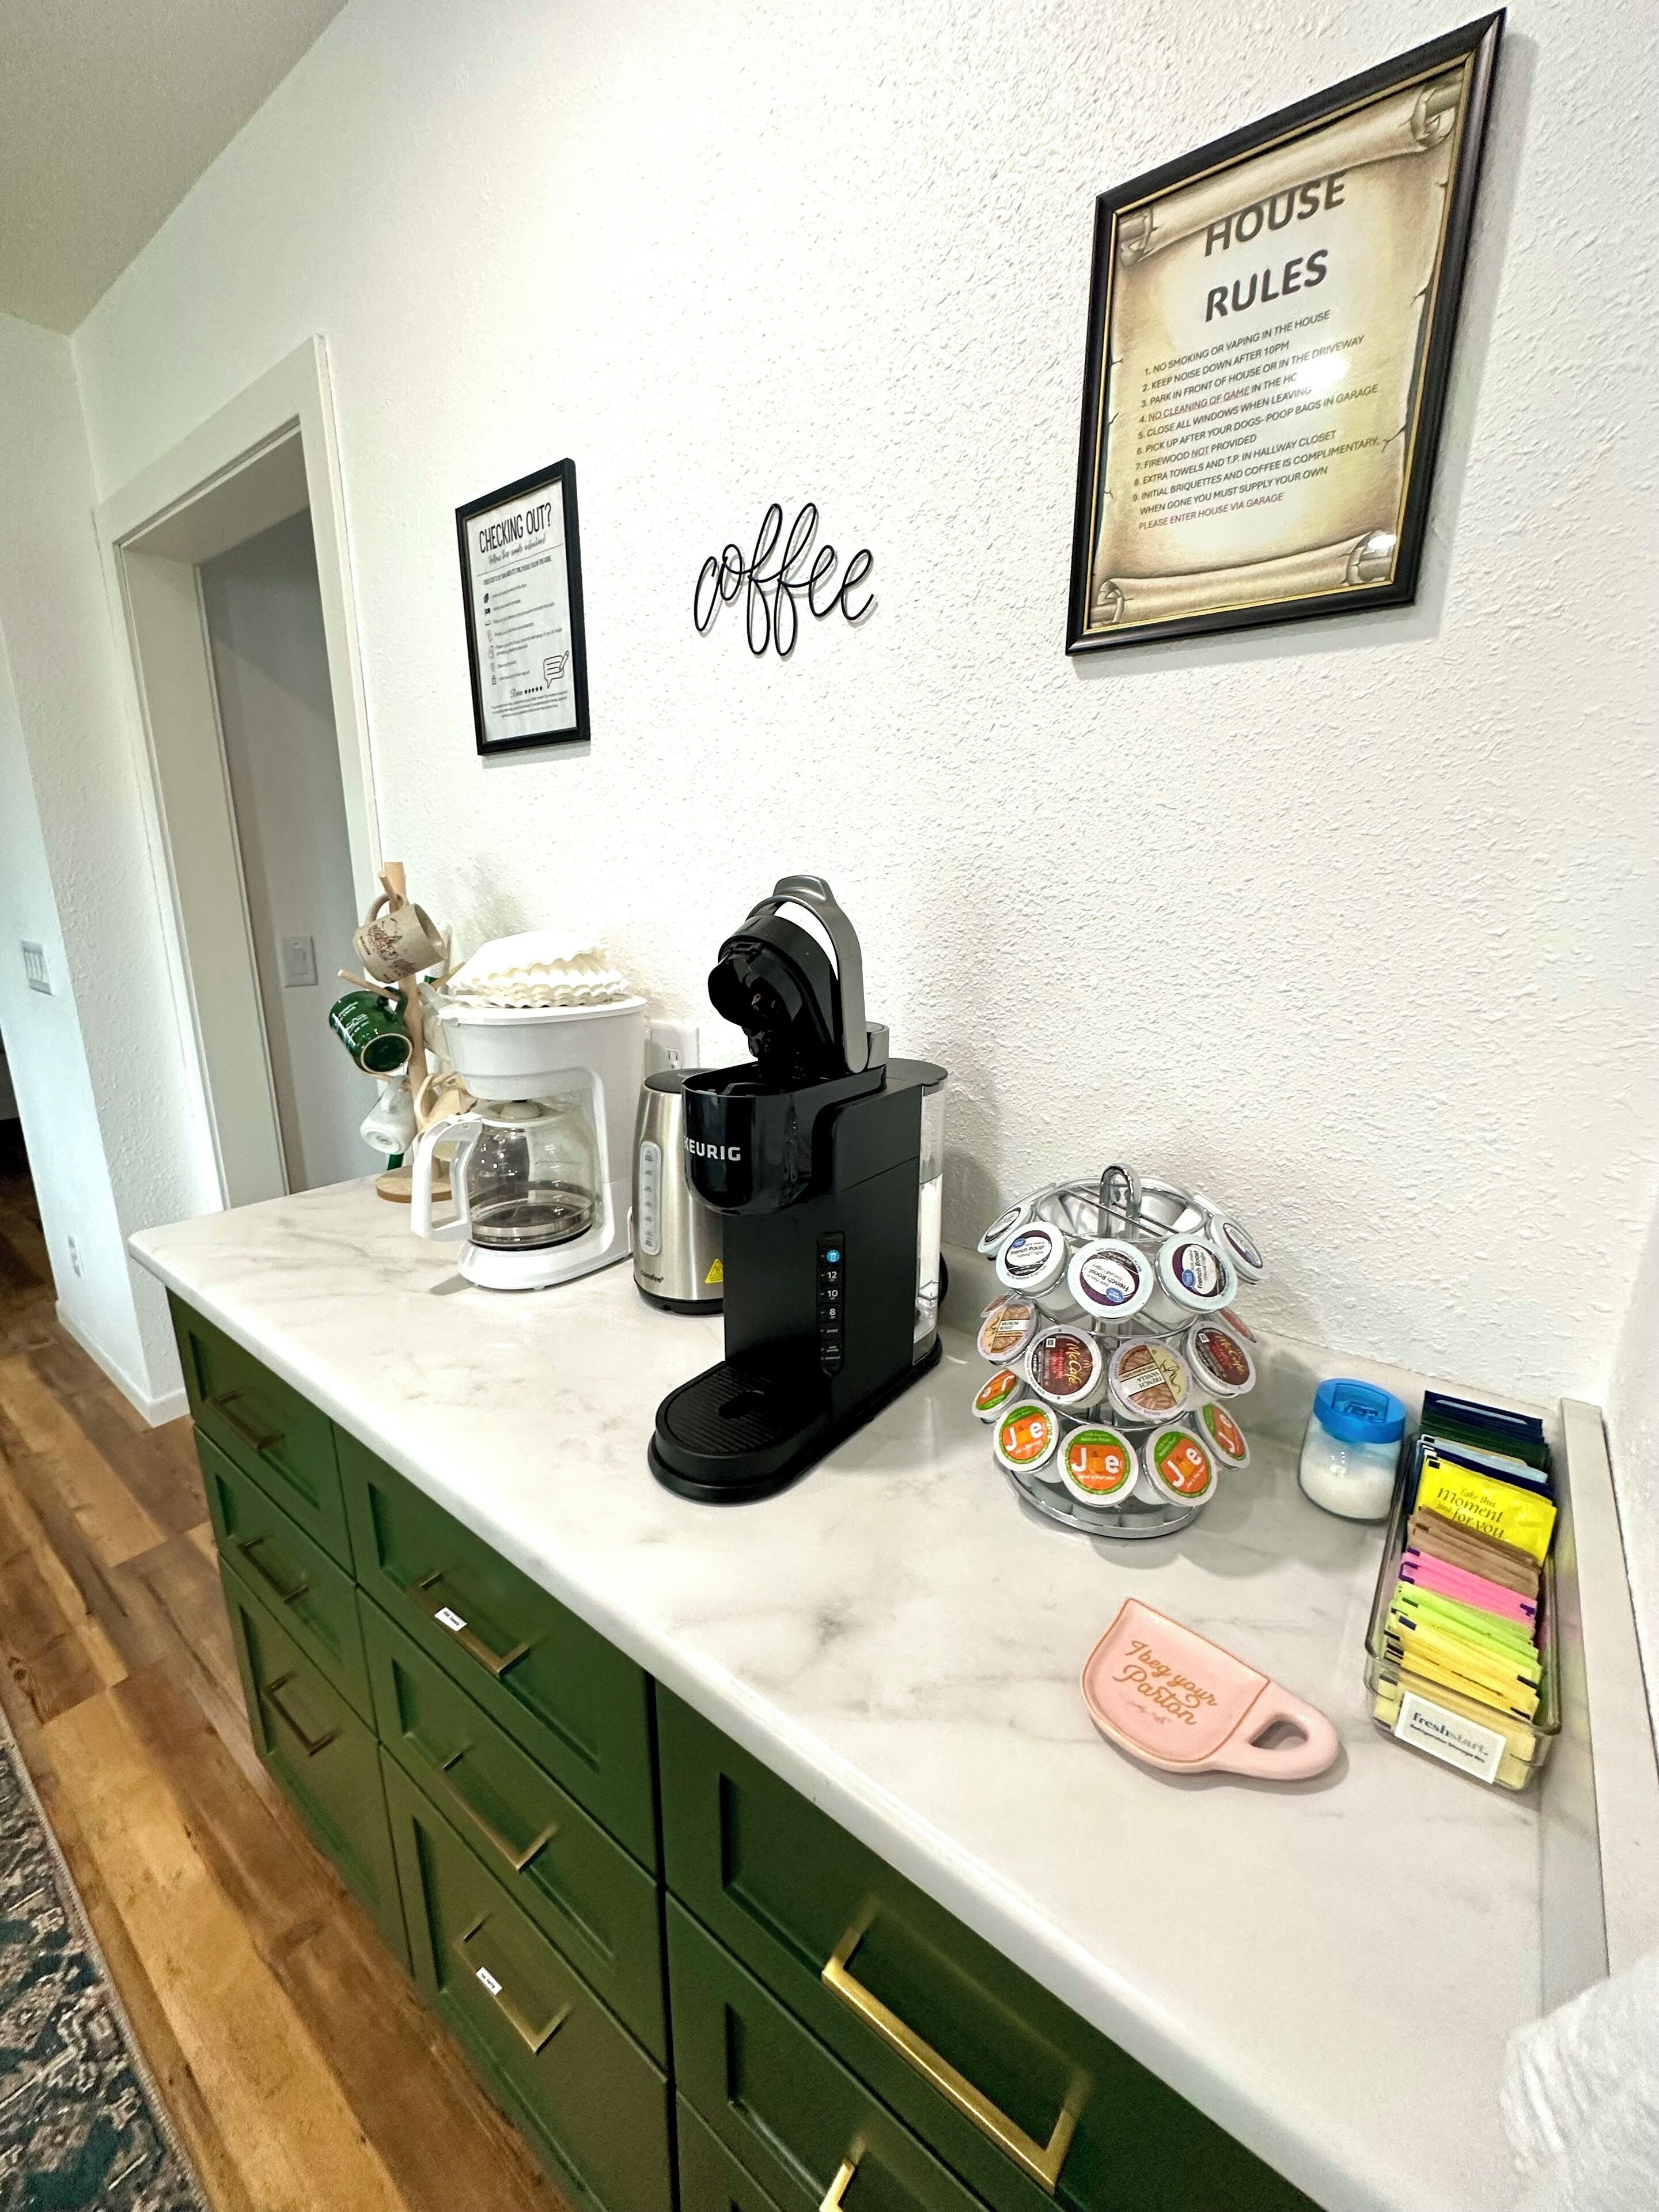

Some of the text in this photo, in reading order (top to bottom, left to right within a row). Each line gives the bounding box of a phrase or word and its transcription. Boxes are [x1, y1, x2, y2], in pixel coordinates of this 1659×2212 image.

[1204, 170, 1348, 257] HOUSE
[1205, 248, 1329, 323] RULES
[1153, 362, 1166, 373] NO
[1168, 349, 1210, 369] SMOKING
[1211, 344, 1224, 355] OR
[1226, 332, 1260, 351] VAPING
[1262, 329, 1272, 339] IN
[1275, 322, 1293, 335] THE
[1294, 309, 1331, 329] HOUSE
[1141, 335, 1365, 408] 3. PARK IN FRONT OF HOUSE OR IN THE DRIVEWAY
[1142, 340, 1290, 392] 2. KEEP NOISE DOWN AFTER 10PM
[1137, 447, 1144, 455] 6.
[1145, 441, 1165, 453] PICK
[1166, 438, 1179, 448] UP
[1179, 431, 1206, 445] AFTER
[1207, 424, 1233, 438] YOUR
[1266, 407, 1294, 423] POOP
[1295, 399, 1322, 415] BAGS
[1323, 396, 1335, 407] IN
[1335, 382, 1380, 403] GARAGE
[1138, 415, 1147, 423] 4.
[1148, 411, 1162, 423] NO
[1163, 399, 1208, 418] CLEANING
[1209, 394, 1223, 406] OF
[1223, 385, 1250, 401] GAME
[1251, 383, 1262, 393] IN
[1264, 377, 1282, 390] THE
[1147, 423, 1176, 438] CLOSE
[1176, 419, 1192, 430] ALL
[1193, 406, 1238, 425] WINDOWS
[1240, 397, 1270, 413] WHEN
[1271, 385, 1313, 405] LEAVING
[1134, 429, 1338, 486] 8. EXTRA TOWELS AND T.P. IN HALLWAY CLOSET
[1135, 434, 1257, 471] 7. FIREWOOD NOT PROVIDED
[1132, 494, 1140, 502] 9.
[1141, 487, 1169, 500] INITIAL
[1170, 474, 1222, 494] BRIQUETTES
[1222, 470, 1243, 482] AND
[1244, 459, 1282, 476] COFFEE
[1282, 457, 1291, 468] IS
[1140, 465, 1328, 515] WHEN GONE YOU MUST SUPPLY YOUR OWN
[479, 514, 524, 554] CHECKING
[526, 502, 552, 535] OUT?
[1138, 491, 1285, 530] PLEASE ENTER HOUSE VIA GARAGE
[694, 502, 875, 657] coffee
[684, 1134, 741, 1161] KEURIG
[827, 1271, 837, 1279] 12
[827, 1289, 839, 1297] 10
[1088, 1268, 1107, 1281] Roast
[1107, 1277, 1130, 1292] French
[1137, 1371, 1160, 1382] VANILLA
[1139, 1376, 1162, 1389] FRENCH
[1437, 1487, 1503, 1522] moment
[1452, 1508, 1474, 1525] for
[1460, 1487, 1497, 1508] Take this
[1112, 1664, 1202, 1726] Parton
[1138, 1649, 1173, 1677] beg
[1167, 1673, 1218, 1707] your
